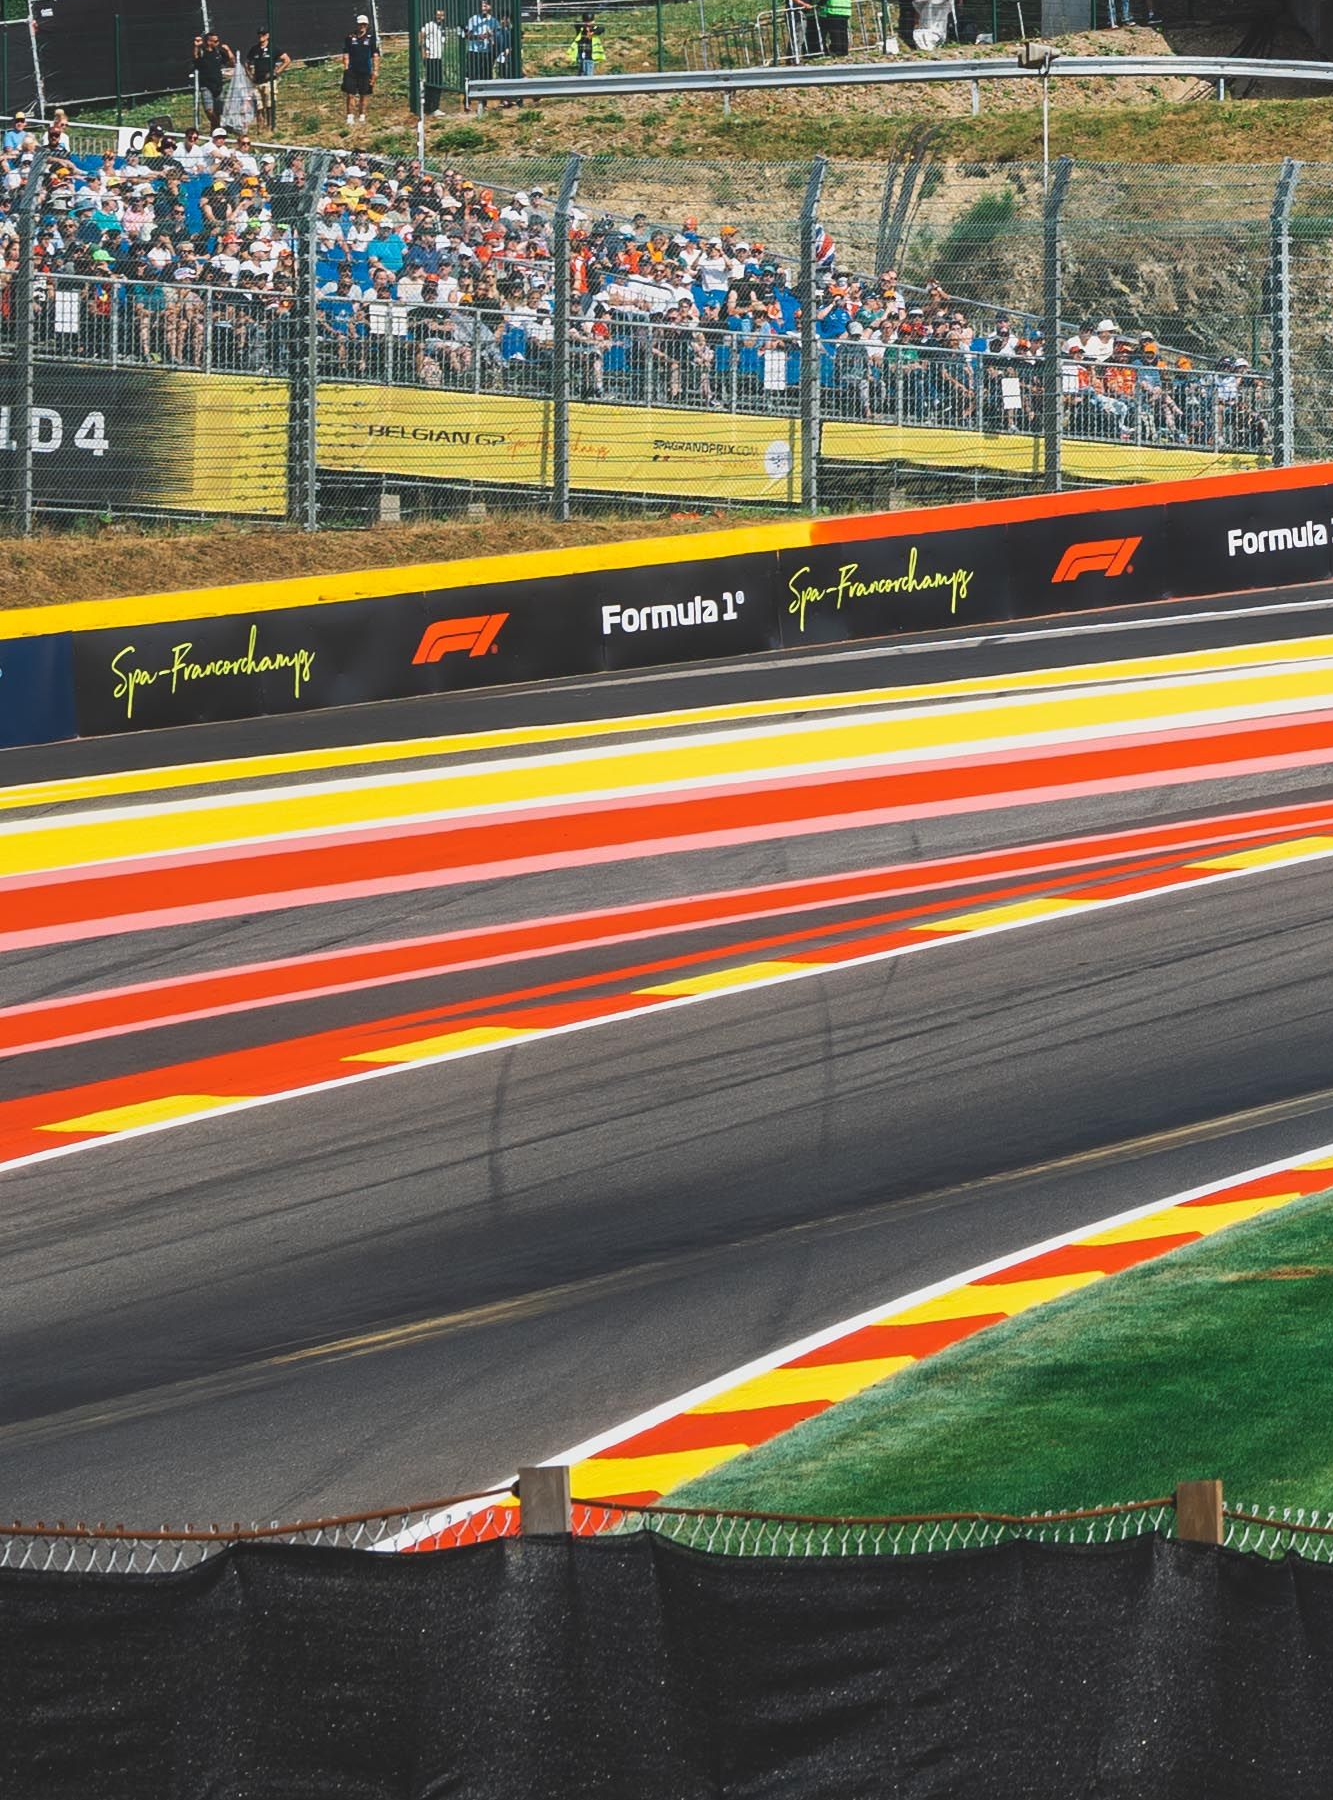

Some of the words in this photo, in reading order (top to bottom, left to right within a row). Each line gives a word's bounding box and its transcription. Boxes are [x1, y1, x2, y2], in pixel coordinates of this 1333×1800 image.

[367, 425, 470, 445] BELGIAN
[1051, 536, 1143, 584] F1
[1227, 521, 1328, 557] Formula
[788, 547, 974, 631] Spa-Francorchamps
[411, 612, 510, 665] F1
[602, 596, 719, 635] Formula
[111, 624, 315, 718] Spa-Francorchamps
